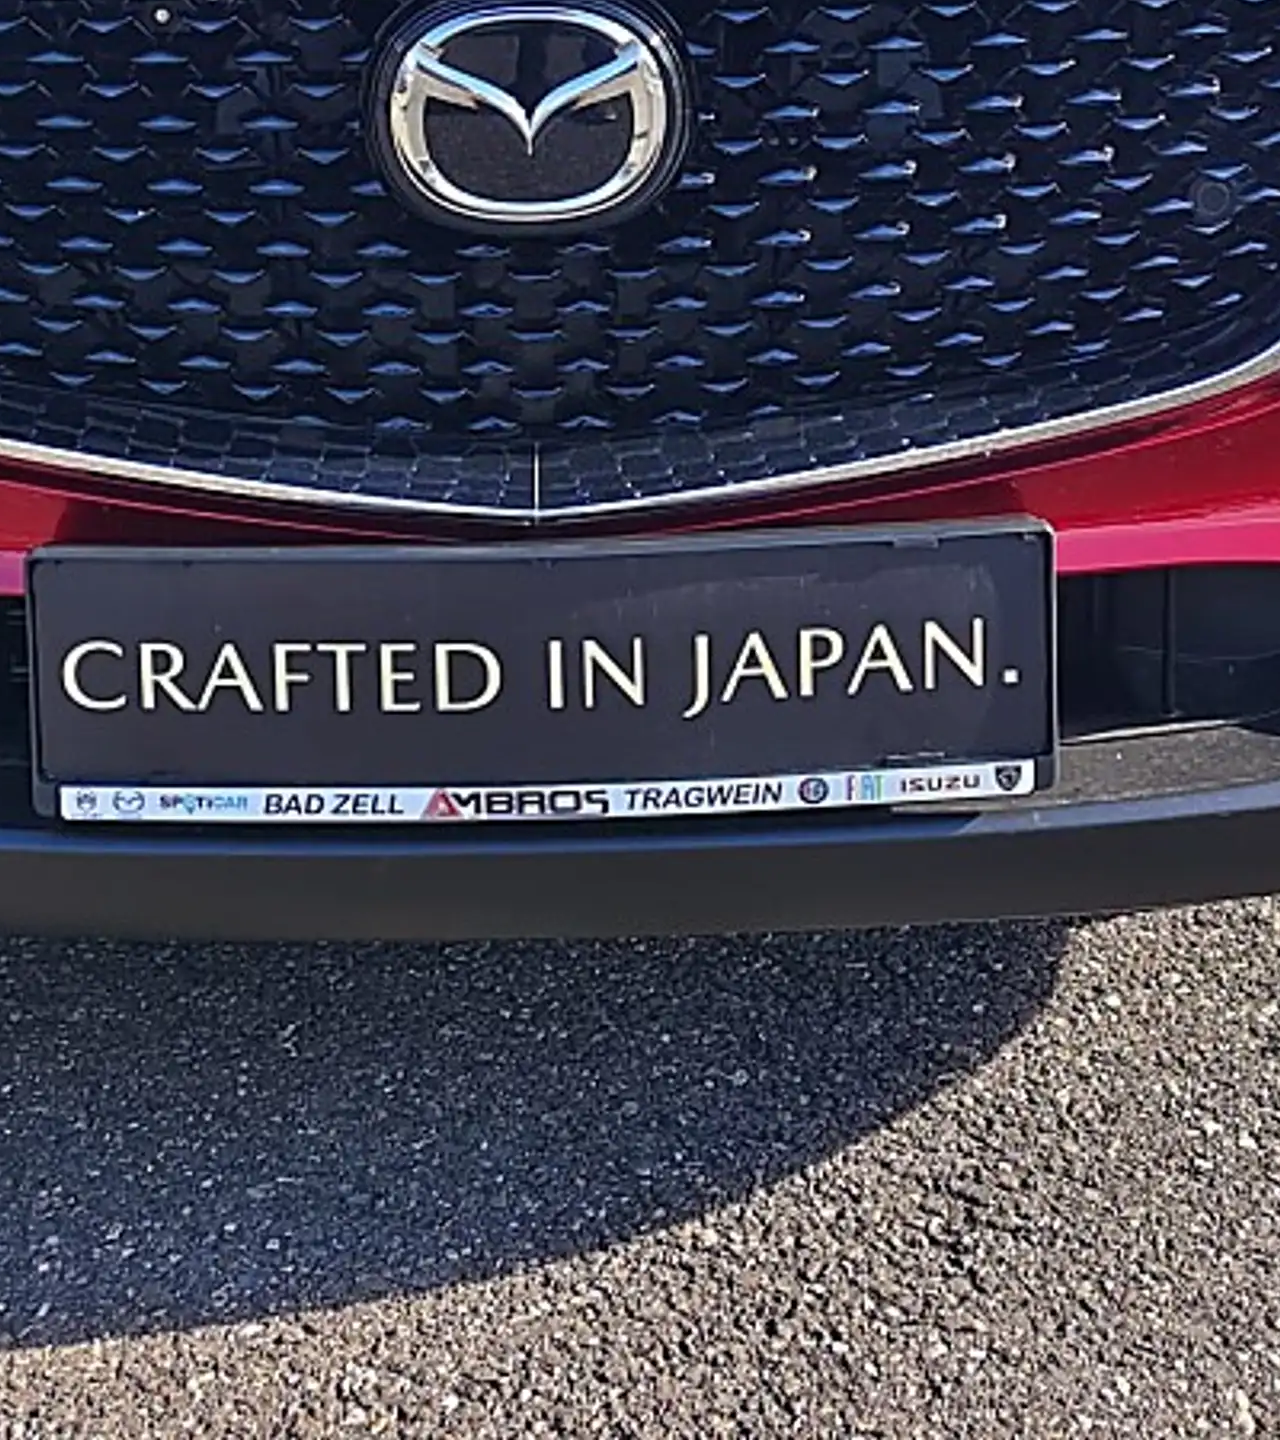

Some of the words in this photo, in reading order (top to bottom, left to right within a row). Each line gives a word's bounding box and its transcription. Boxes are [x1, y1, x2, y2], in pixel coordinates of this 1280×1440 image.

[61, 639, 503, 713] CRAFTED
[548, 636, 646, 710] IN
[682, 616, 1020, 720] JAPAN.
[263, 792, 325, 816] BAD
[330, 793, 405, 815] ZELL
[421, 787, 610, 819] AMBROS
[625, 781, 783, 812] TRAGWEIN
[899, 773, 981, 794] ISUZU
